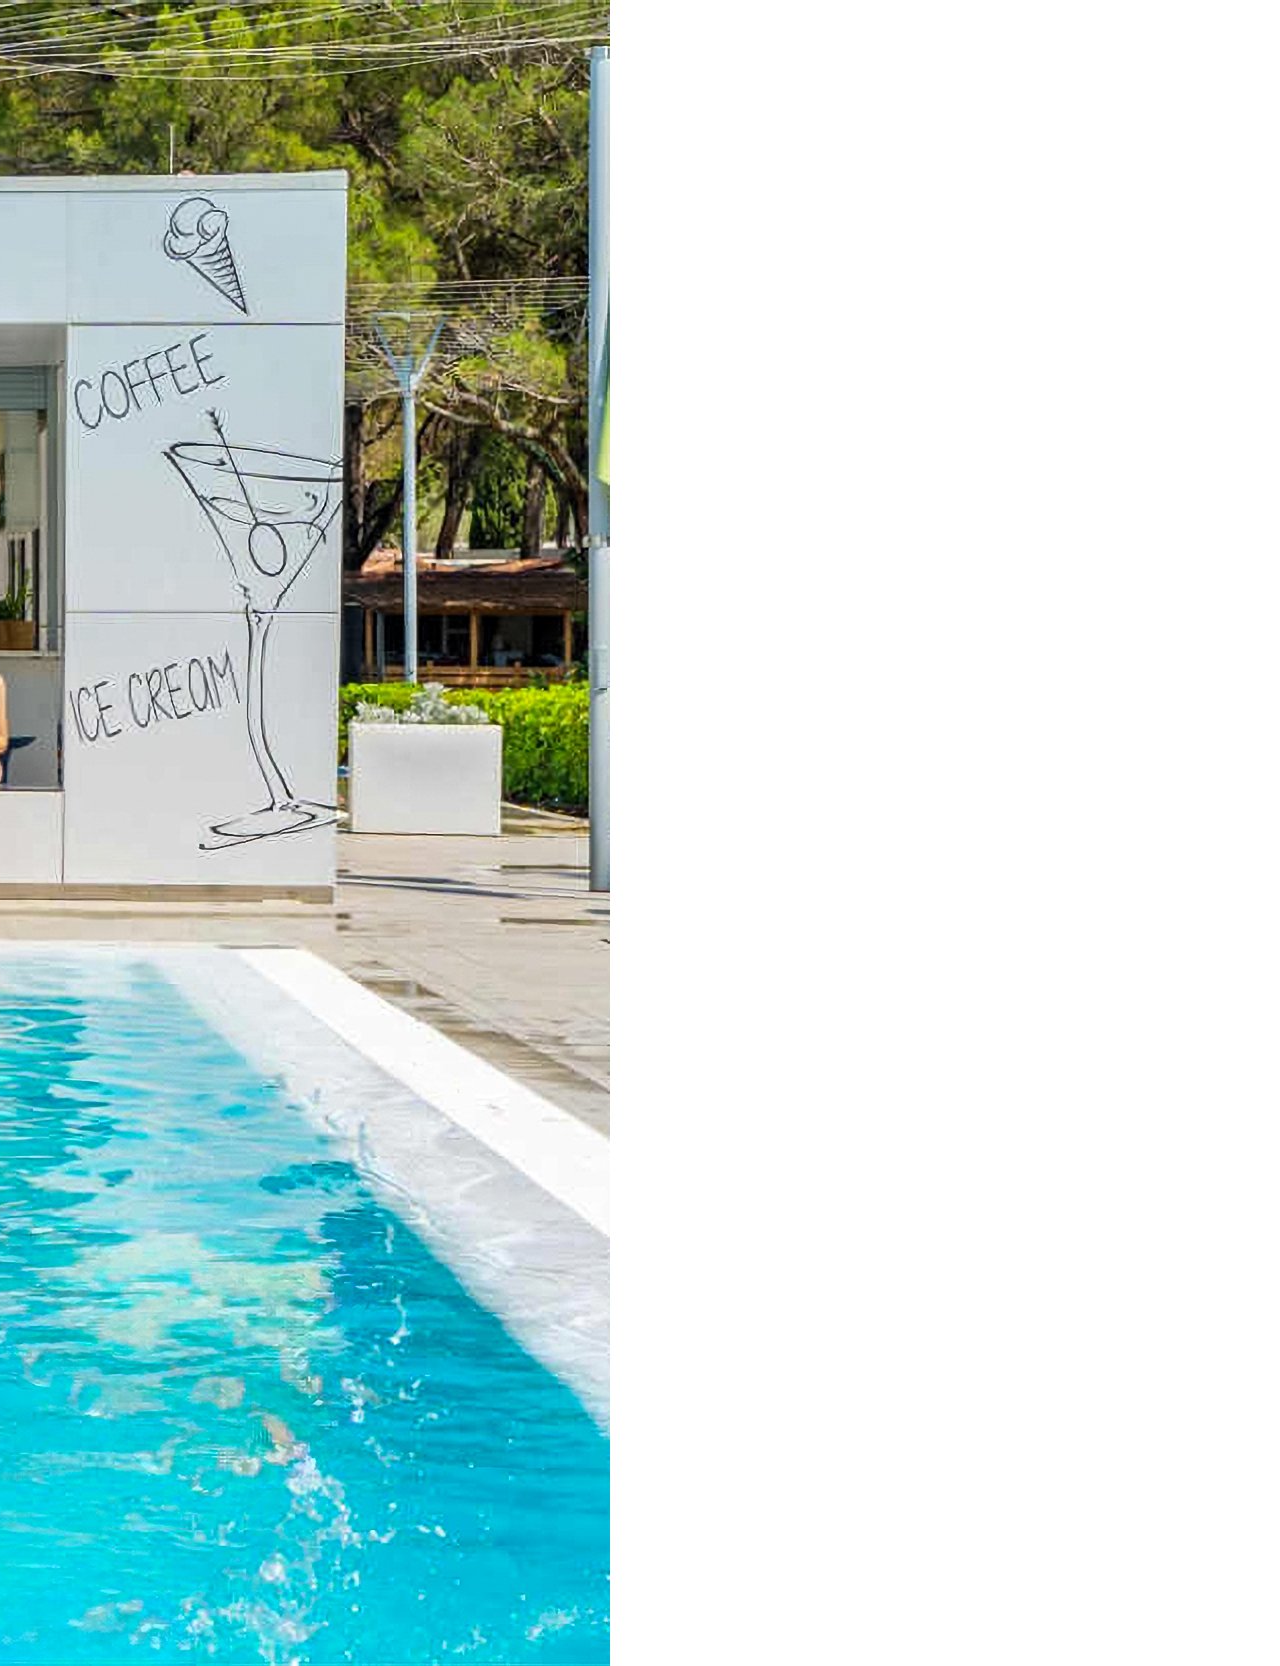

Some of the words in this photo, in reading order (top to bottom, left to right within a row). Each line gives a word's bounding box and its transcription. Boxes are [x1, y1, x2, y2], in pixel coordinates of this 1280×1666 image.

[74, 333, 225, 429] COFFEE
[69, 680, 122, 741] ICE
[129, 646, 241, 728] CREAM
